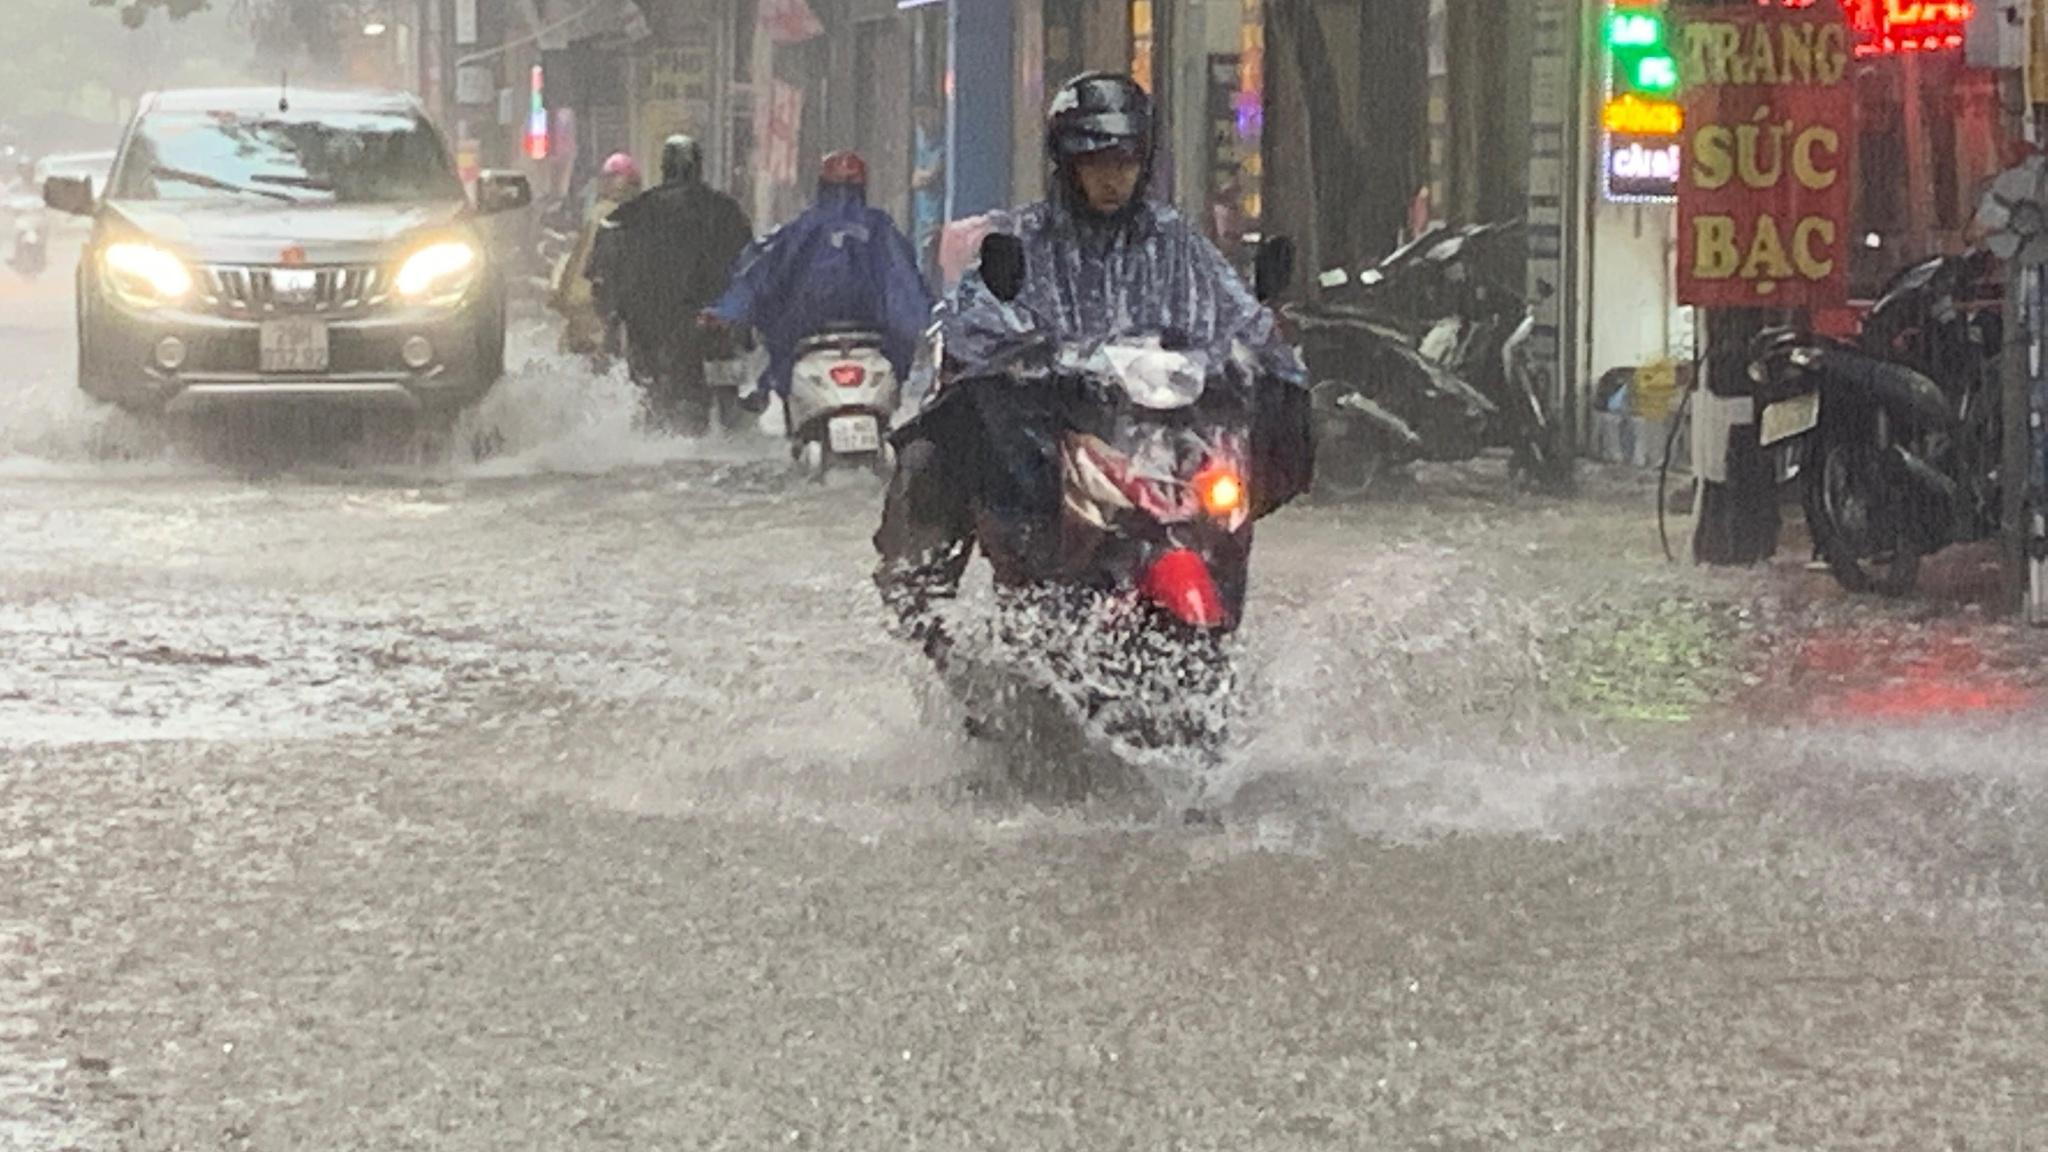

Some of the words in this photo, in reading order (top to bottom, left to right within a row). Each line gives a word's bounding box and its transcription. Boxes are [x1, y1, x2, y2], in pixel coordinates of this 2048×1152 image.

[1684, 21, 1847, 85] TRANG
[1692, 105, 1839, 190] SỨC
[1692, 213, 1836, 295] BẠC
